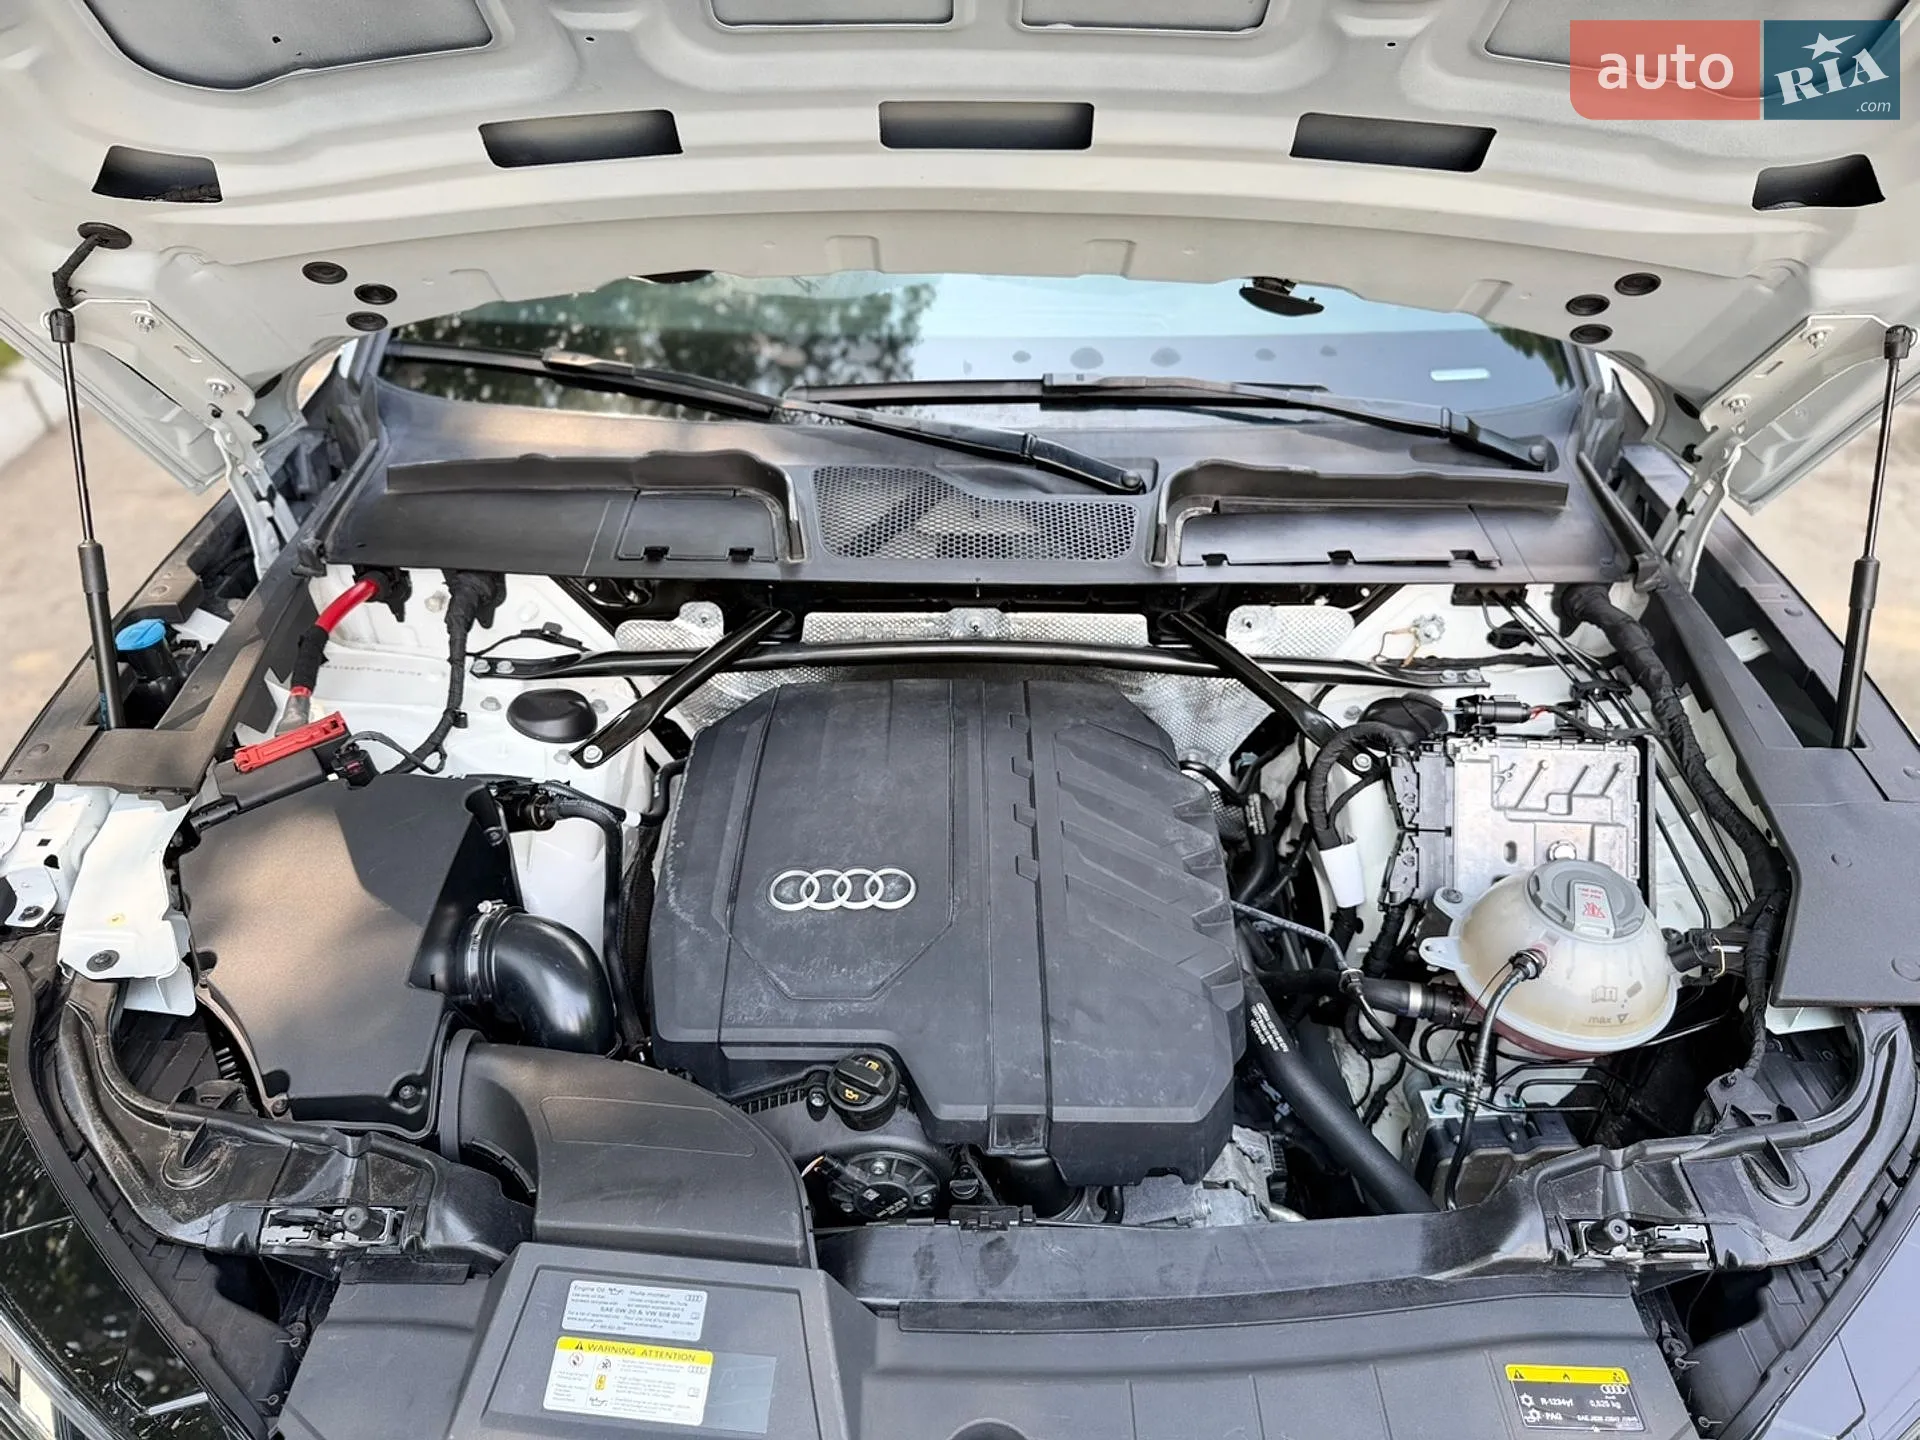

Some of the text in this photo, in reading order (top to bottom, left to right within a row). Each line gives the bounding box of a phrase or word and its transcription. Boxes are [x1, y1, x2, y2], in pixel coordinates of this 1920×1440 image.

[1588, 1015, 1612, 1024] max
[587, 1342, 697, 1362] WARNING ATTENTION
